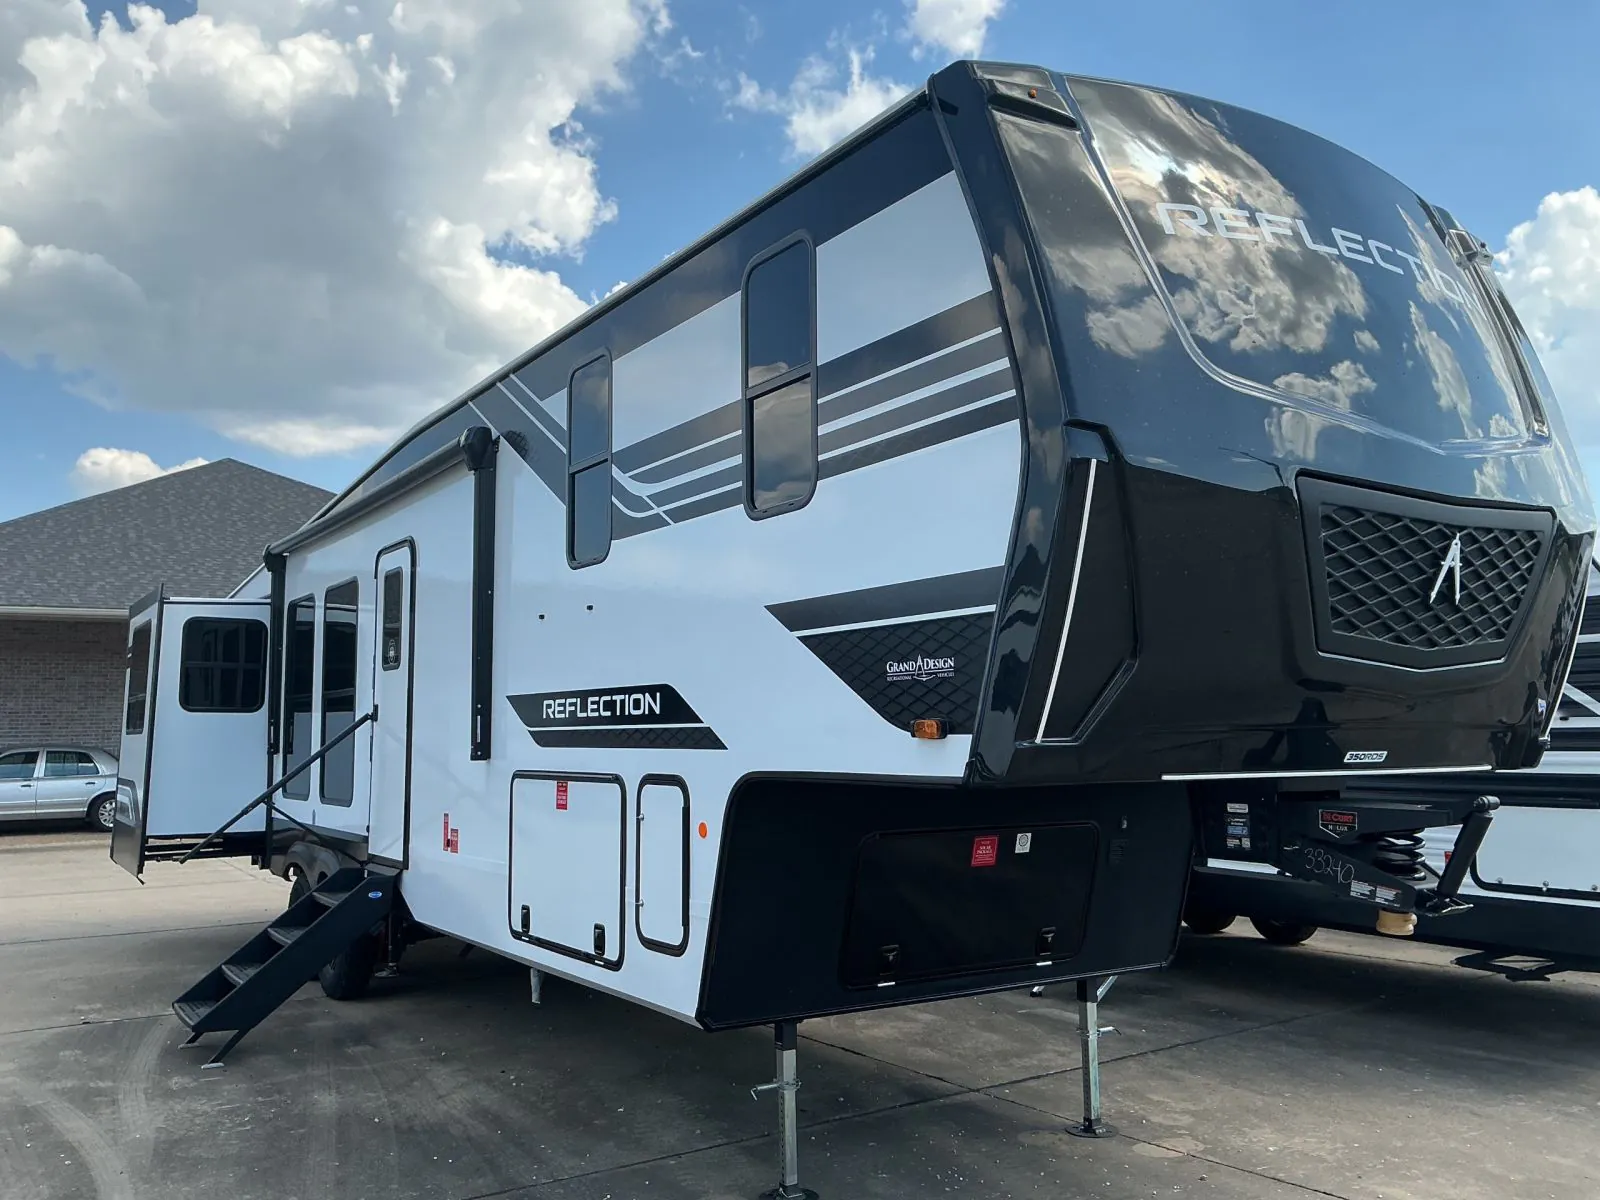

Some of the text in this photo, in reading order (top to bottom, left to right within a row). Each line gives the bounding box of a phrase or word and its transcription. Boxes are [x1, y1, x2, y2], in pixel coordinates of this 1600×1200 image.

[1156, 202, 1488, 321] REFLECTION
[886, 657, 955, 673] GRAND DESIGN
[542, 692, 661, 719] REFLECTION
[1304, 848, 1355, 884] 33240
